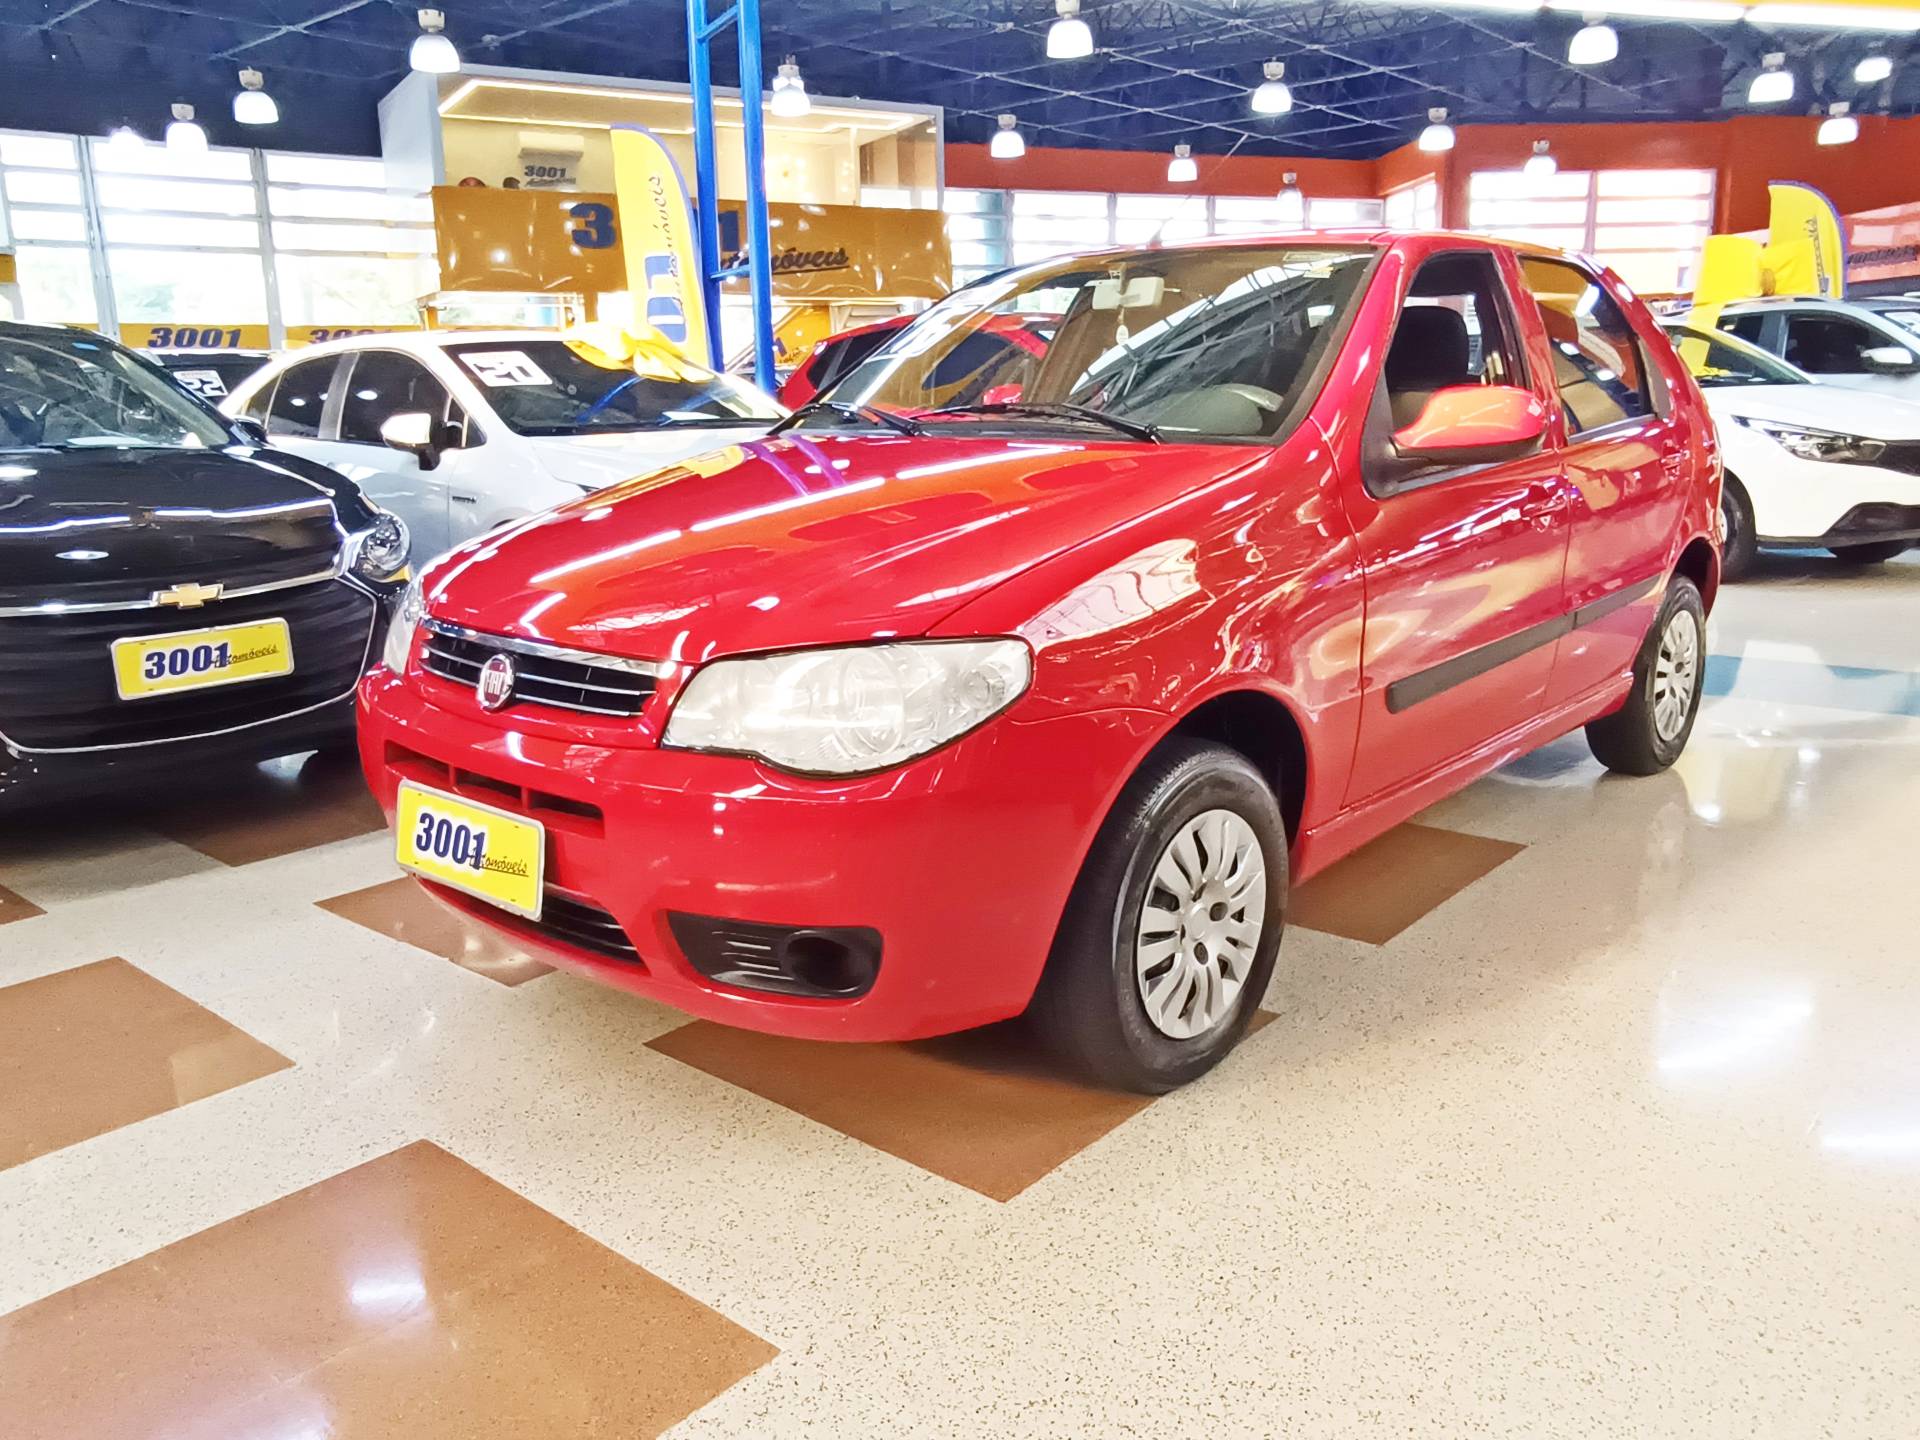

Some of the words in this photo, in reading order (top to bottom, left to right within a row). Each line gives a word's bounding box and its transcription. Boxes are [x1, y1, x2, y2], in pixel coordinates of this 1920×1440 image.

[524, 165, 567, 178] 3001
[147, 327, 242, 349] 3001
[144, 642, 229, 680] 3001
[483, 669, 507, 696] FIAT
[416, 812, 485, 870] 3001
